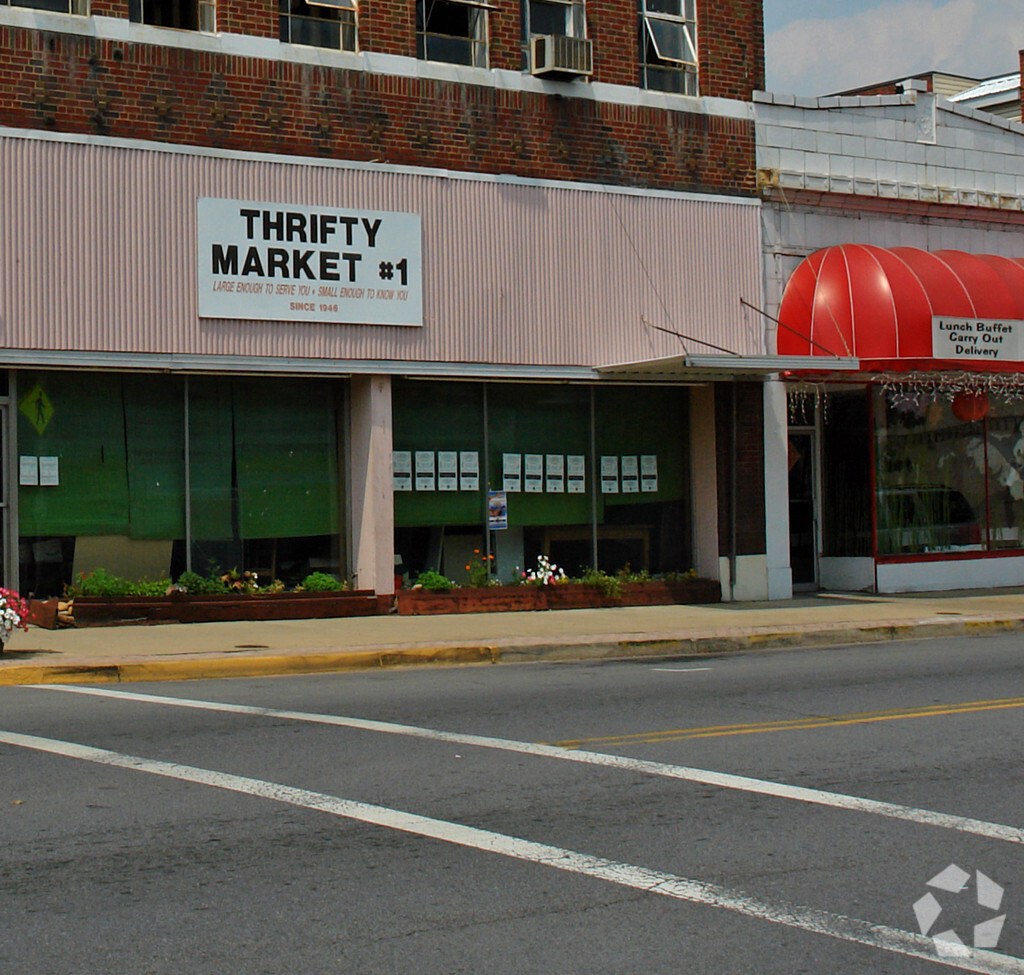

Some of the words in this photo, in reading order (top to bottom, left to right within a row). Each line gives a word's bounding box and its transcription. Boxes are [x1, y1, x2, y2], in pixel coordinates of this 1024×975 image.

[240, 208, 382, 248] THRIFTY
[212, 244, 362, 282] MARKET
[379, 258, 408, 286] #1
[212, 280, 235, 293] LARGE
[236, 282, 264, 294] ENOUGH
[265, 283, 274, 295] TO
[275, 284, 296, 296] SERVE
[298, 285, 310, 297] YOU
[317, 286, 338, 298] SMALL
[340, 287, 365, 300] ENOUGH
[366, 288, 375, 300] TO
[376, 289, 395, 301] KNOW
[396, 290, 409, 302] YOU
[289, 302, 316, 312] SINCE
[319, 304, 338, 313] 1946
[939, 320, 973, 332] Lunch
[976, 322, 1012, 333] Buffet
[949, 332, 978, 344] Carry
[982, 333, 1004, 343] Out
[955, 344, 999, 358] Delivery
